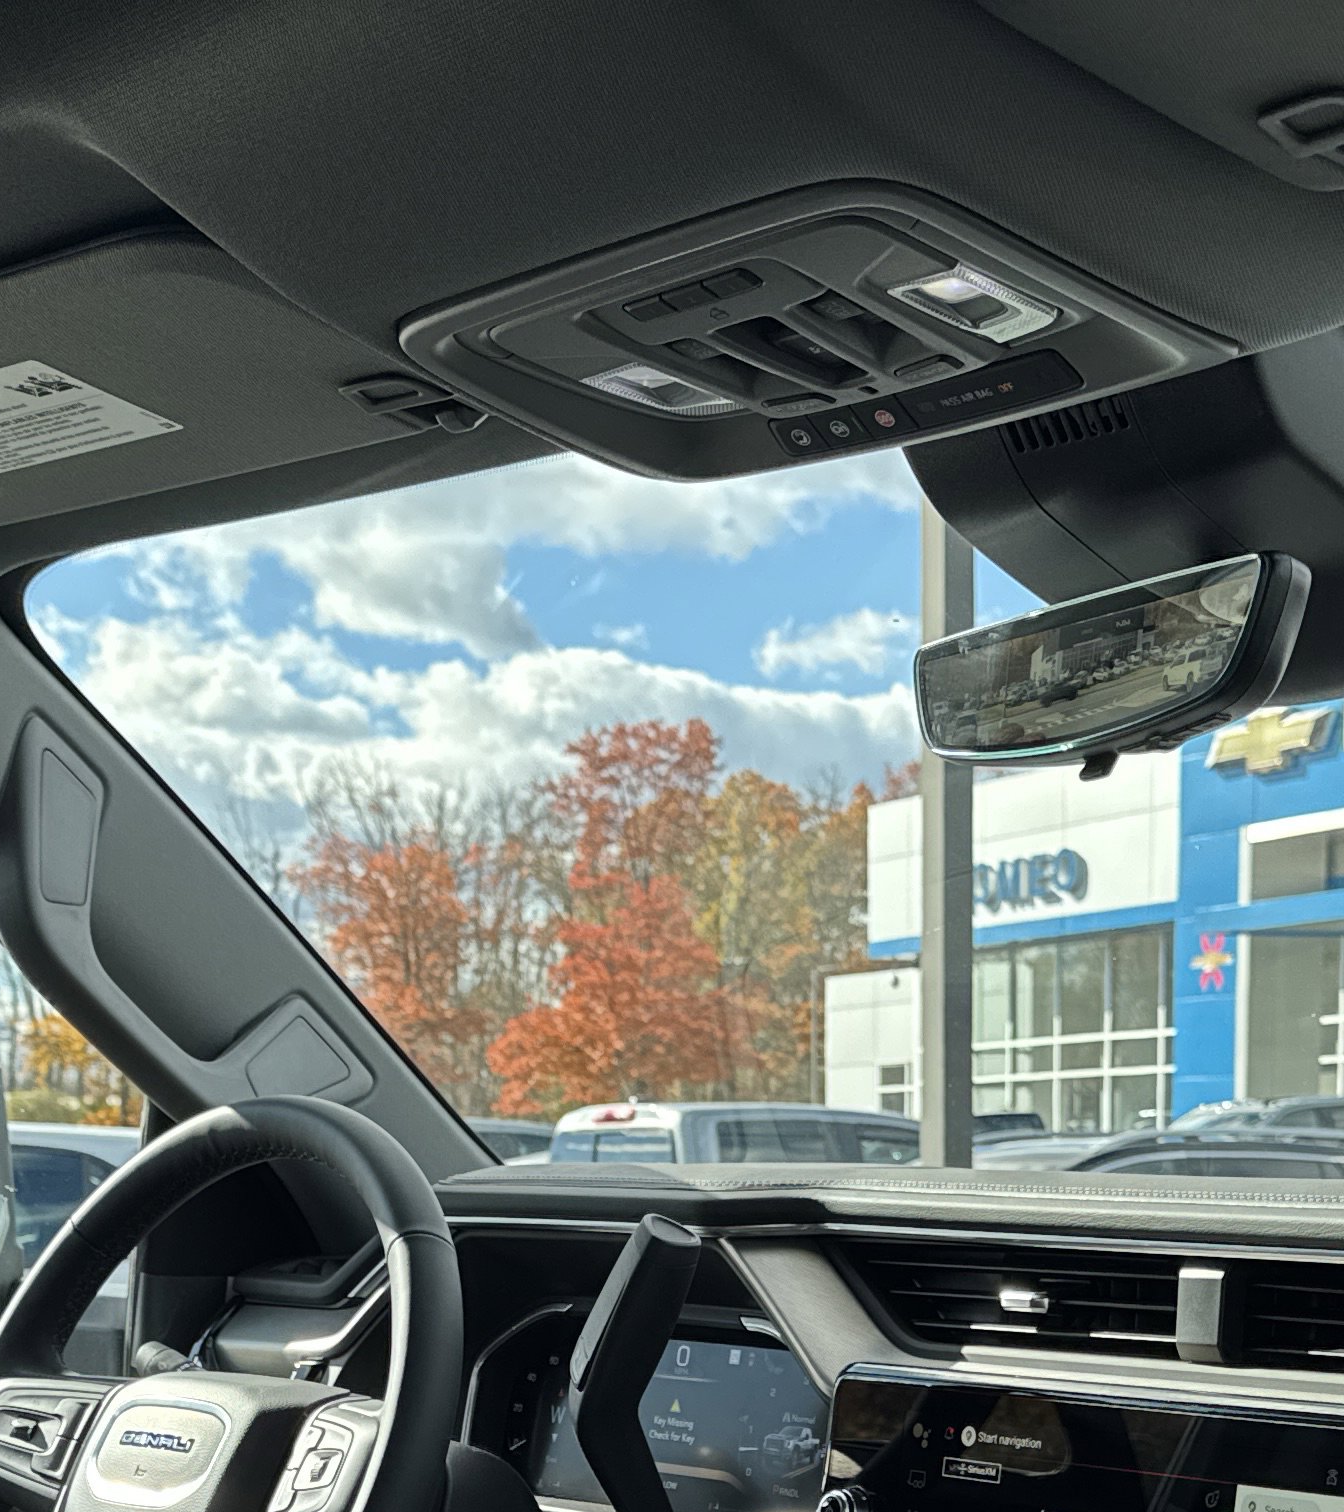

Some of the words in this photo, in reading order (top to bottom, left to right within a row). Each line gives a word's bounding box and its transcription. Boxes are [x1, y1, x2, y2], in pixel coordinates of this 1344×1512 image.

[972, 848, 1080, 903] OMEO
[676, 1344, 690, 1367] 0
[653, 1415, 667, 1428] Key
[667, 1417, 695, 1431] Missing
[648, 1430, 670, 1441] Check
[670, 1432, 681, 1442] for
[681, 1433, 696, 1446] Key
[977, 1431, 998, 1445] Start
[998, 1436, 1042, 1450] navigation
